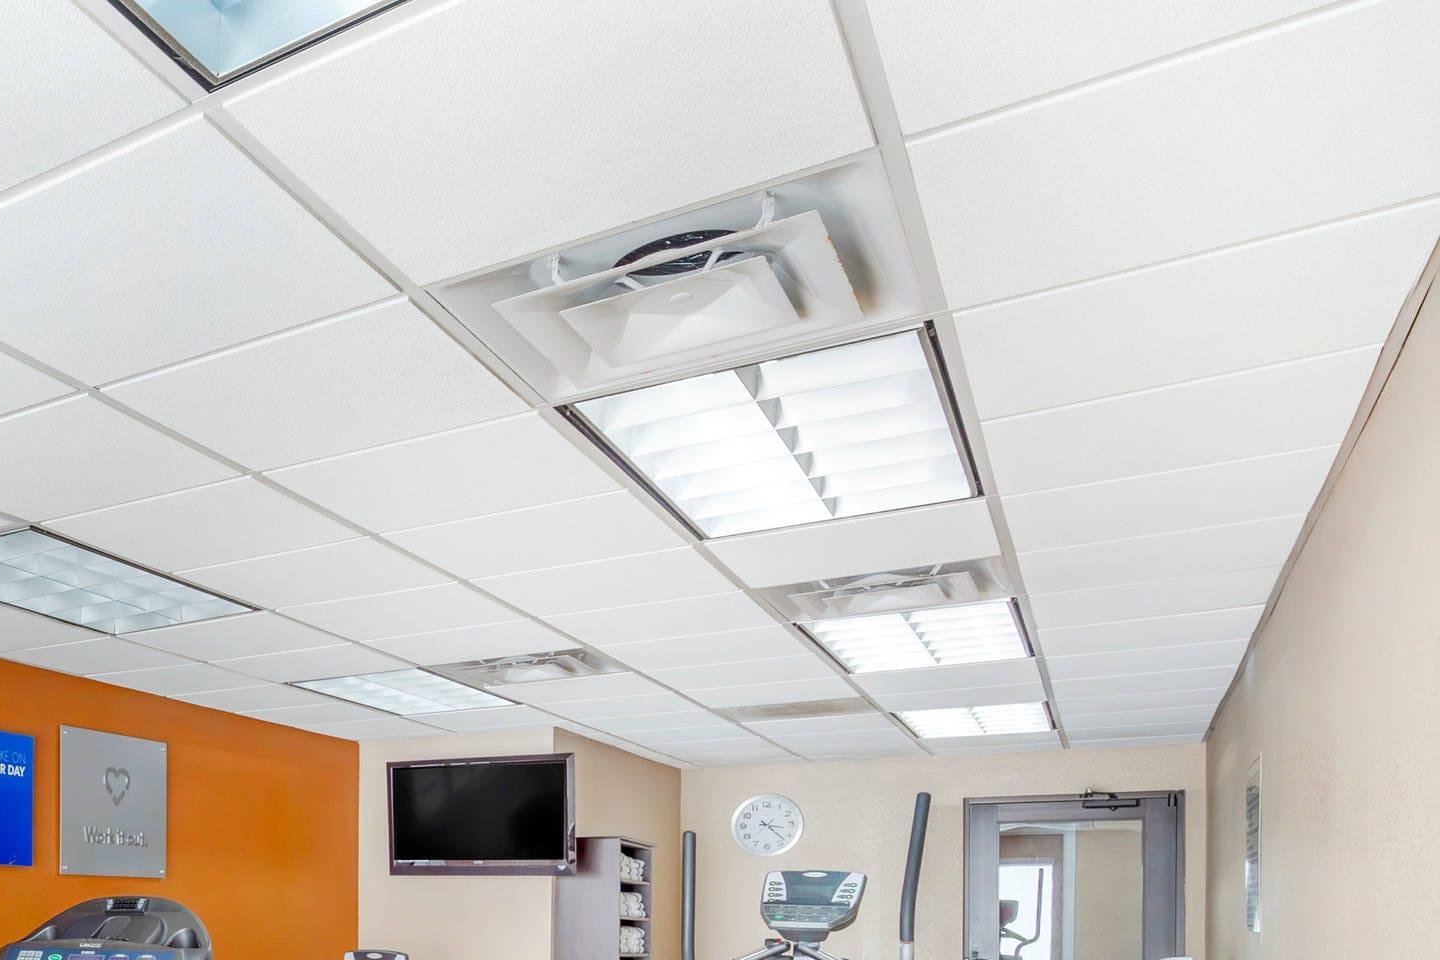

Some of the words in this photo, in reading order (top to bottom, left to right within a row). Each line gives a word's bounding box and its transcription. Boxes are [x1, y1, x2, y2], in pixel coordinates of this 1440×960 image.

[12, 752, 26, 764] ON
[8, 764, 26, 777] DAY
[83, 825, 113, 845] Work
[115, 830, 124, 845] it
